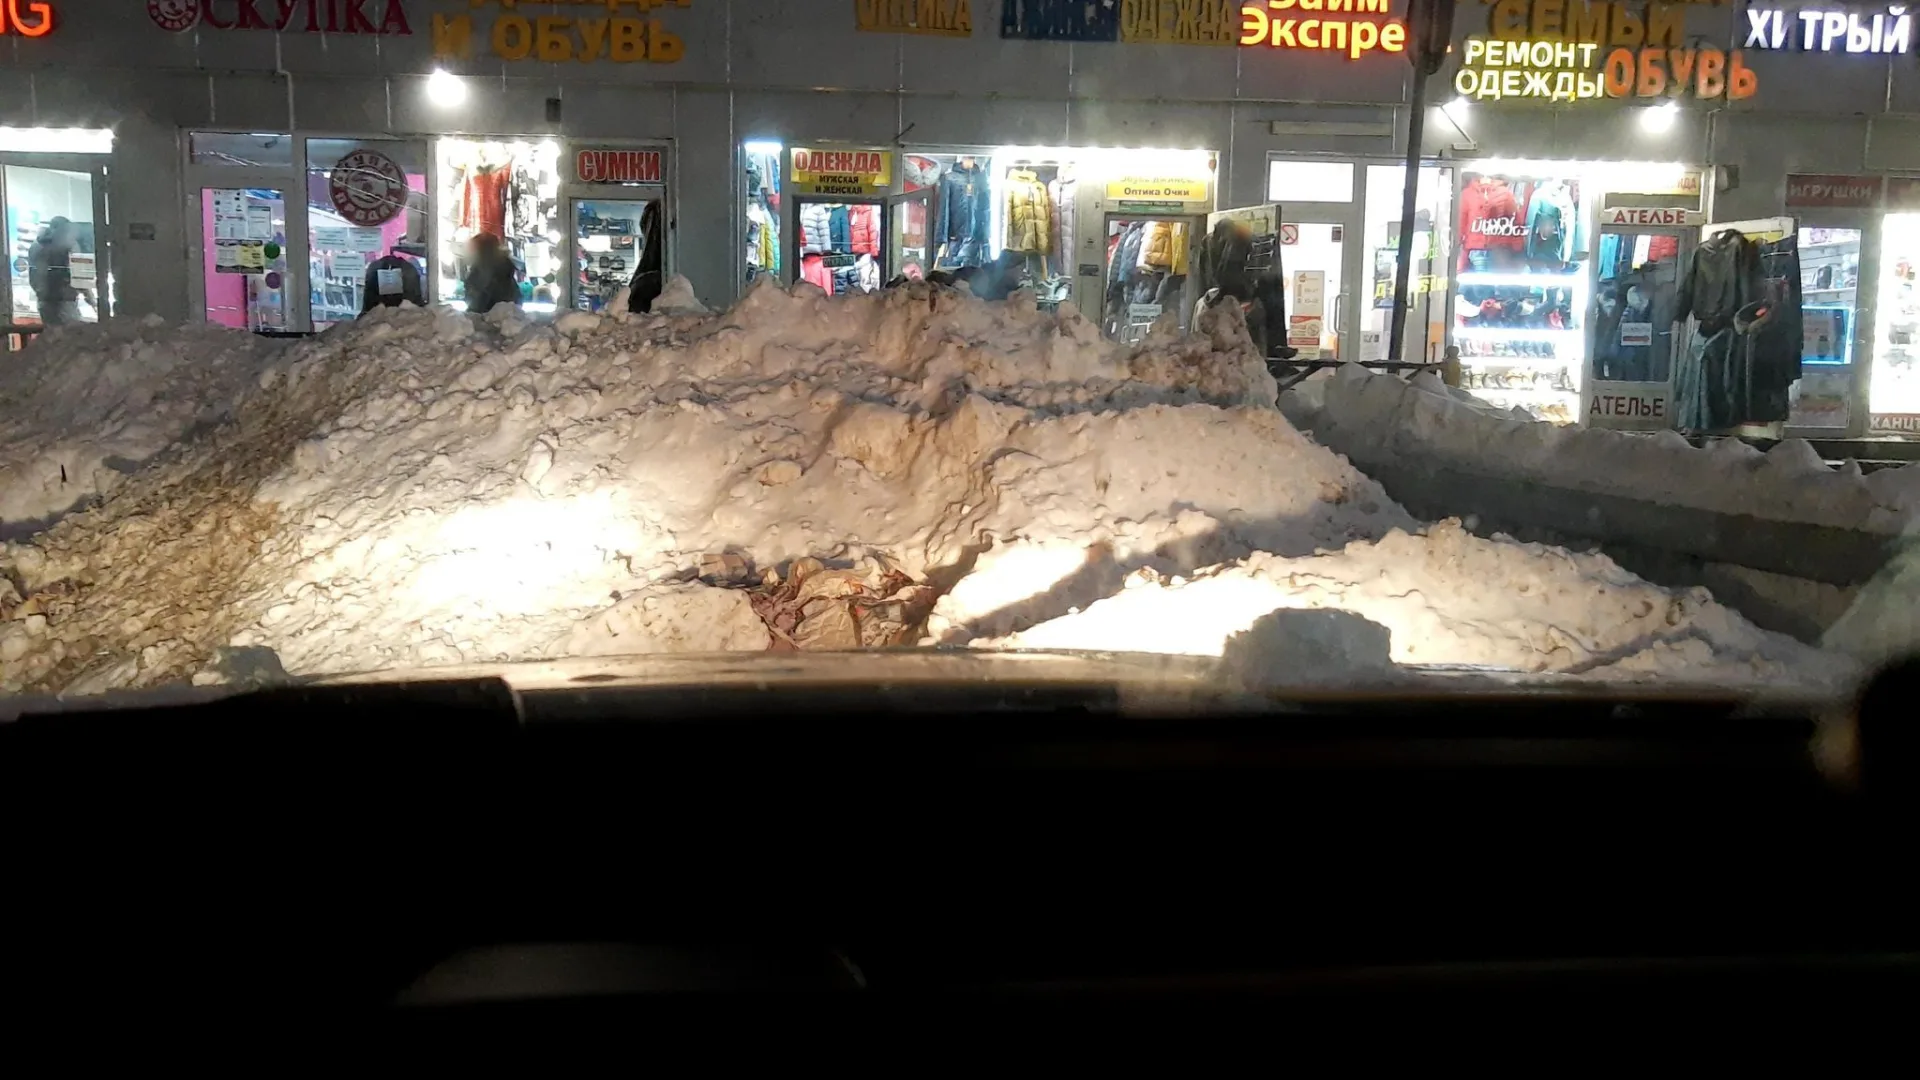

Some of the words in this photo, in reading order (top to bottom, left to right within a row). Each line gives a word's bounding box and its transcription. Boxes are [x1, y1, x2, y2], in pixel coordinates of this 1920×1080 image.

[1121, 0, 1236, 43] ОДЕЖДА
[1240, 7, 1405, 59] Экспре
[1492, 0, 1687, 45] СЕМЬИ
[493, 14, 686, 63] ОБУВЬ
[1465, 40, 1598, 68] РЕМОНТ
[1455, 70, 1604, 101] ОДЕЖДЫ
[1604, 47, 1758, 100] ОБУВЬ
[577, 150, 661, 182] СУМКИ
[795, 151, 881, 174] ОДЕЖДА
[819, 175, 859, 184] МУЖСКАЯ
[824, 186, 862, 195] ЖЕНСКАЯ
[1124, 187, 1161, 196] Оптика
[1164, 187, 1190, 197] Очки
[1789, 183, 1873, 199] ИГРУШКИ
[1613, 209, 1686, 224] АТЕЛЬЕ
[1590, 395, 1664, 417] АТЕЛЬЕ
